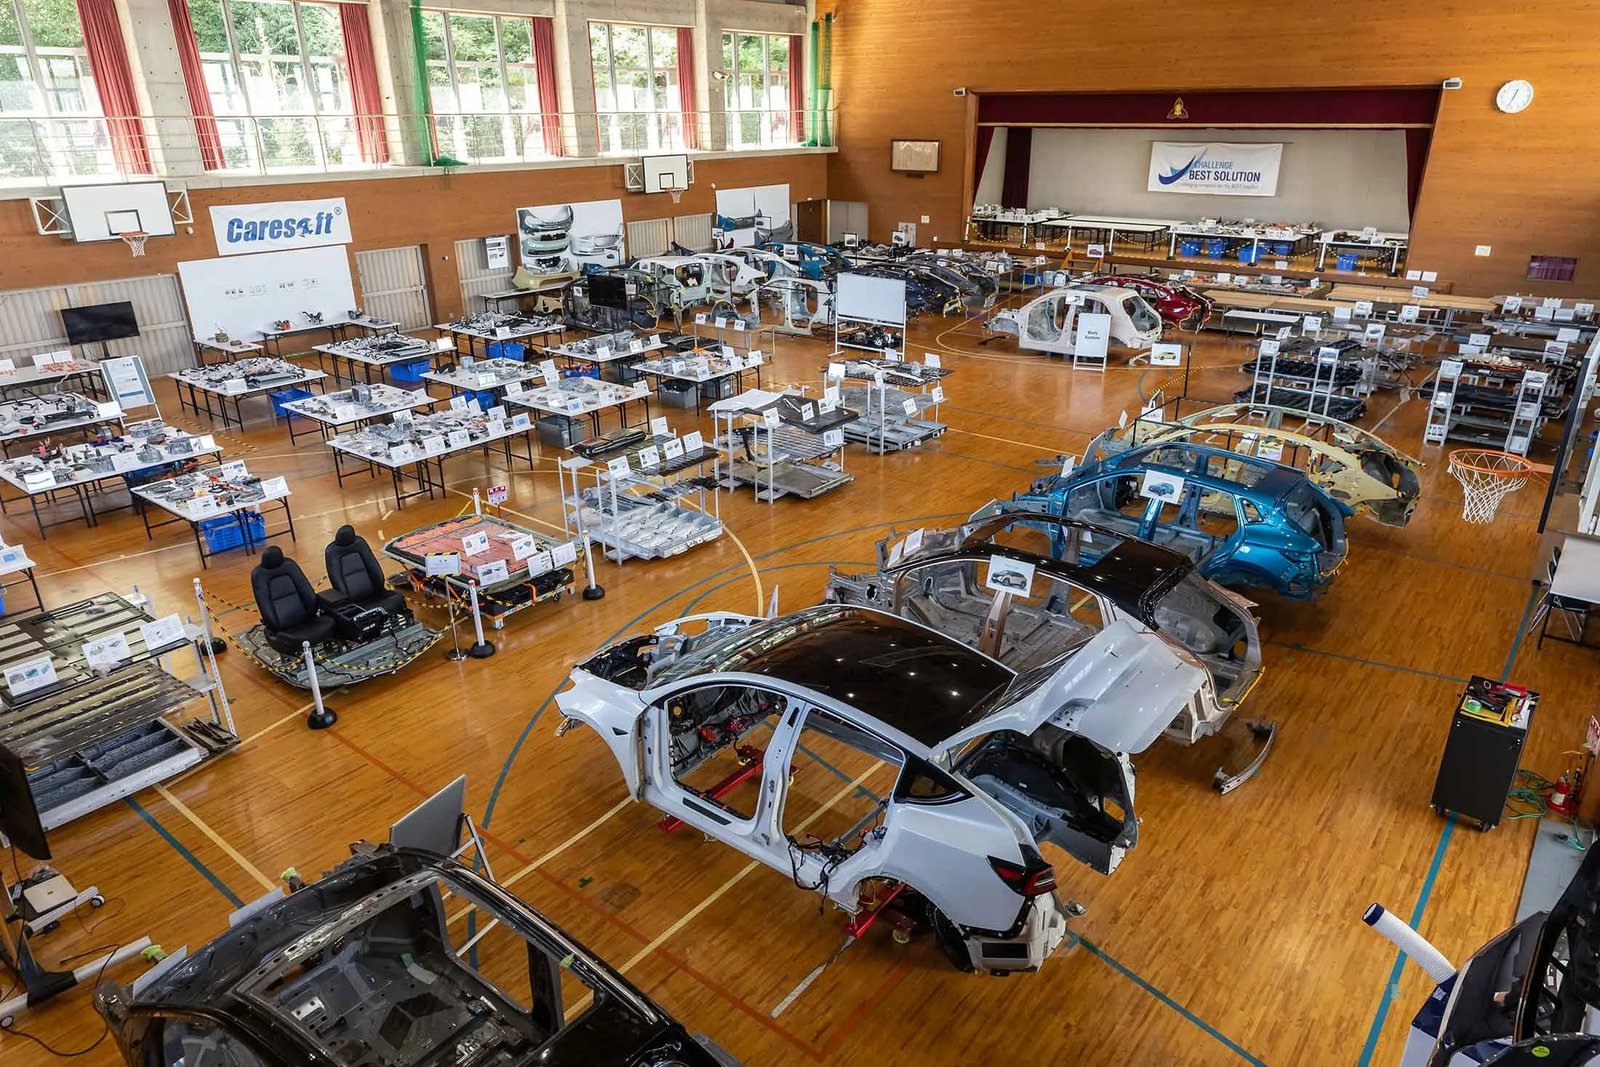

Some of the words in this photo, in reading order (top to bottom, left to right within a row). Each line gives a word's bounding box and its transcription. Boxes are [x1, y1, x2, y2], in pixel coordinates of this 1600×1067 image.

[1194, 161, 1234, 169] CHALLENGE
[1189, 170, 1212, 181] BEST
[1213, 171, 1261, 182] SOLUTION
